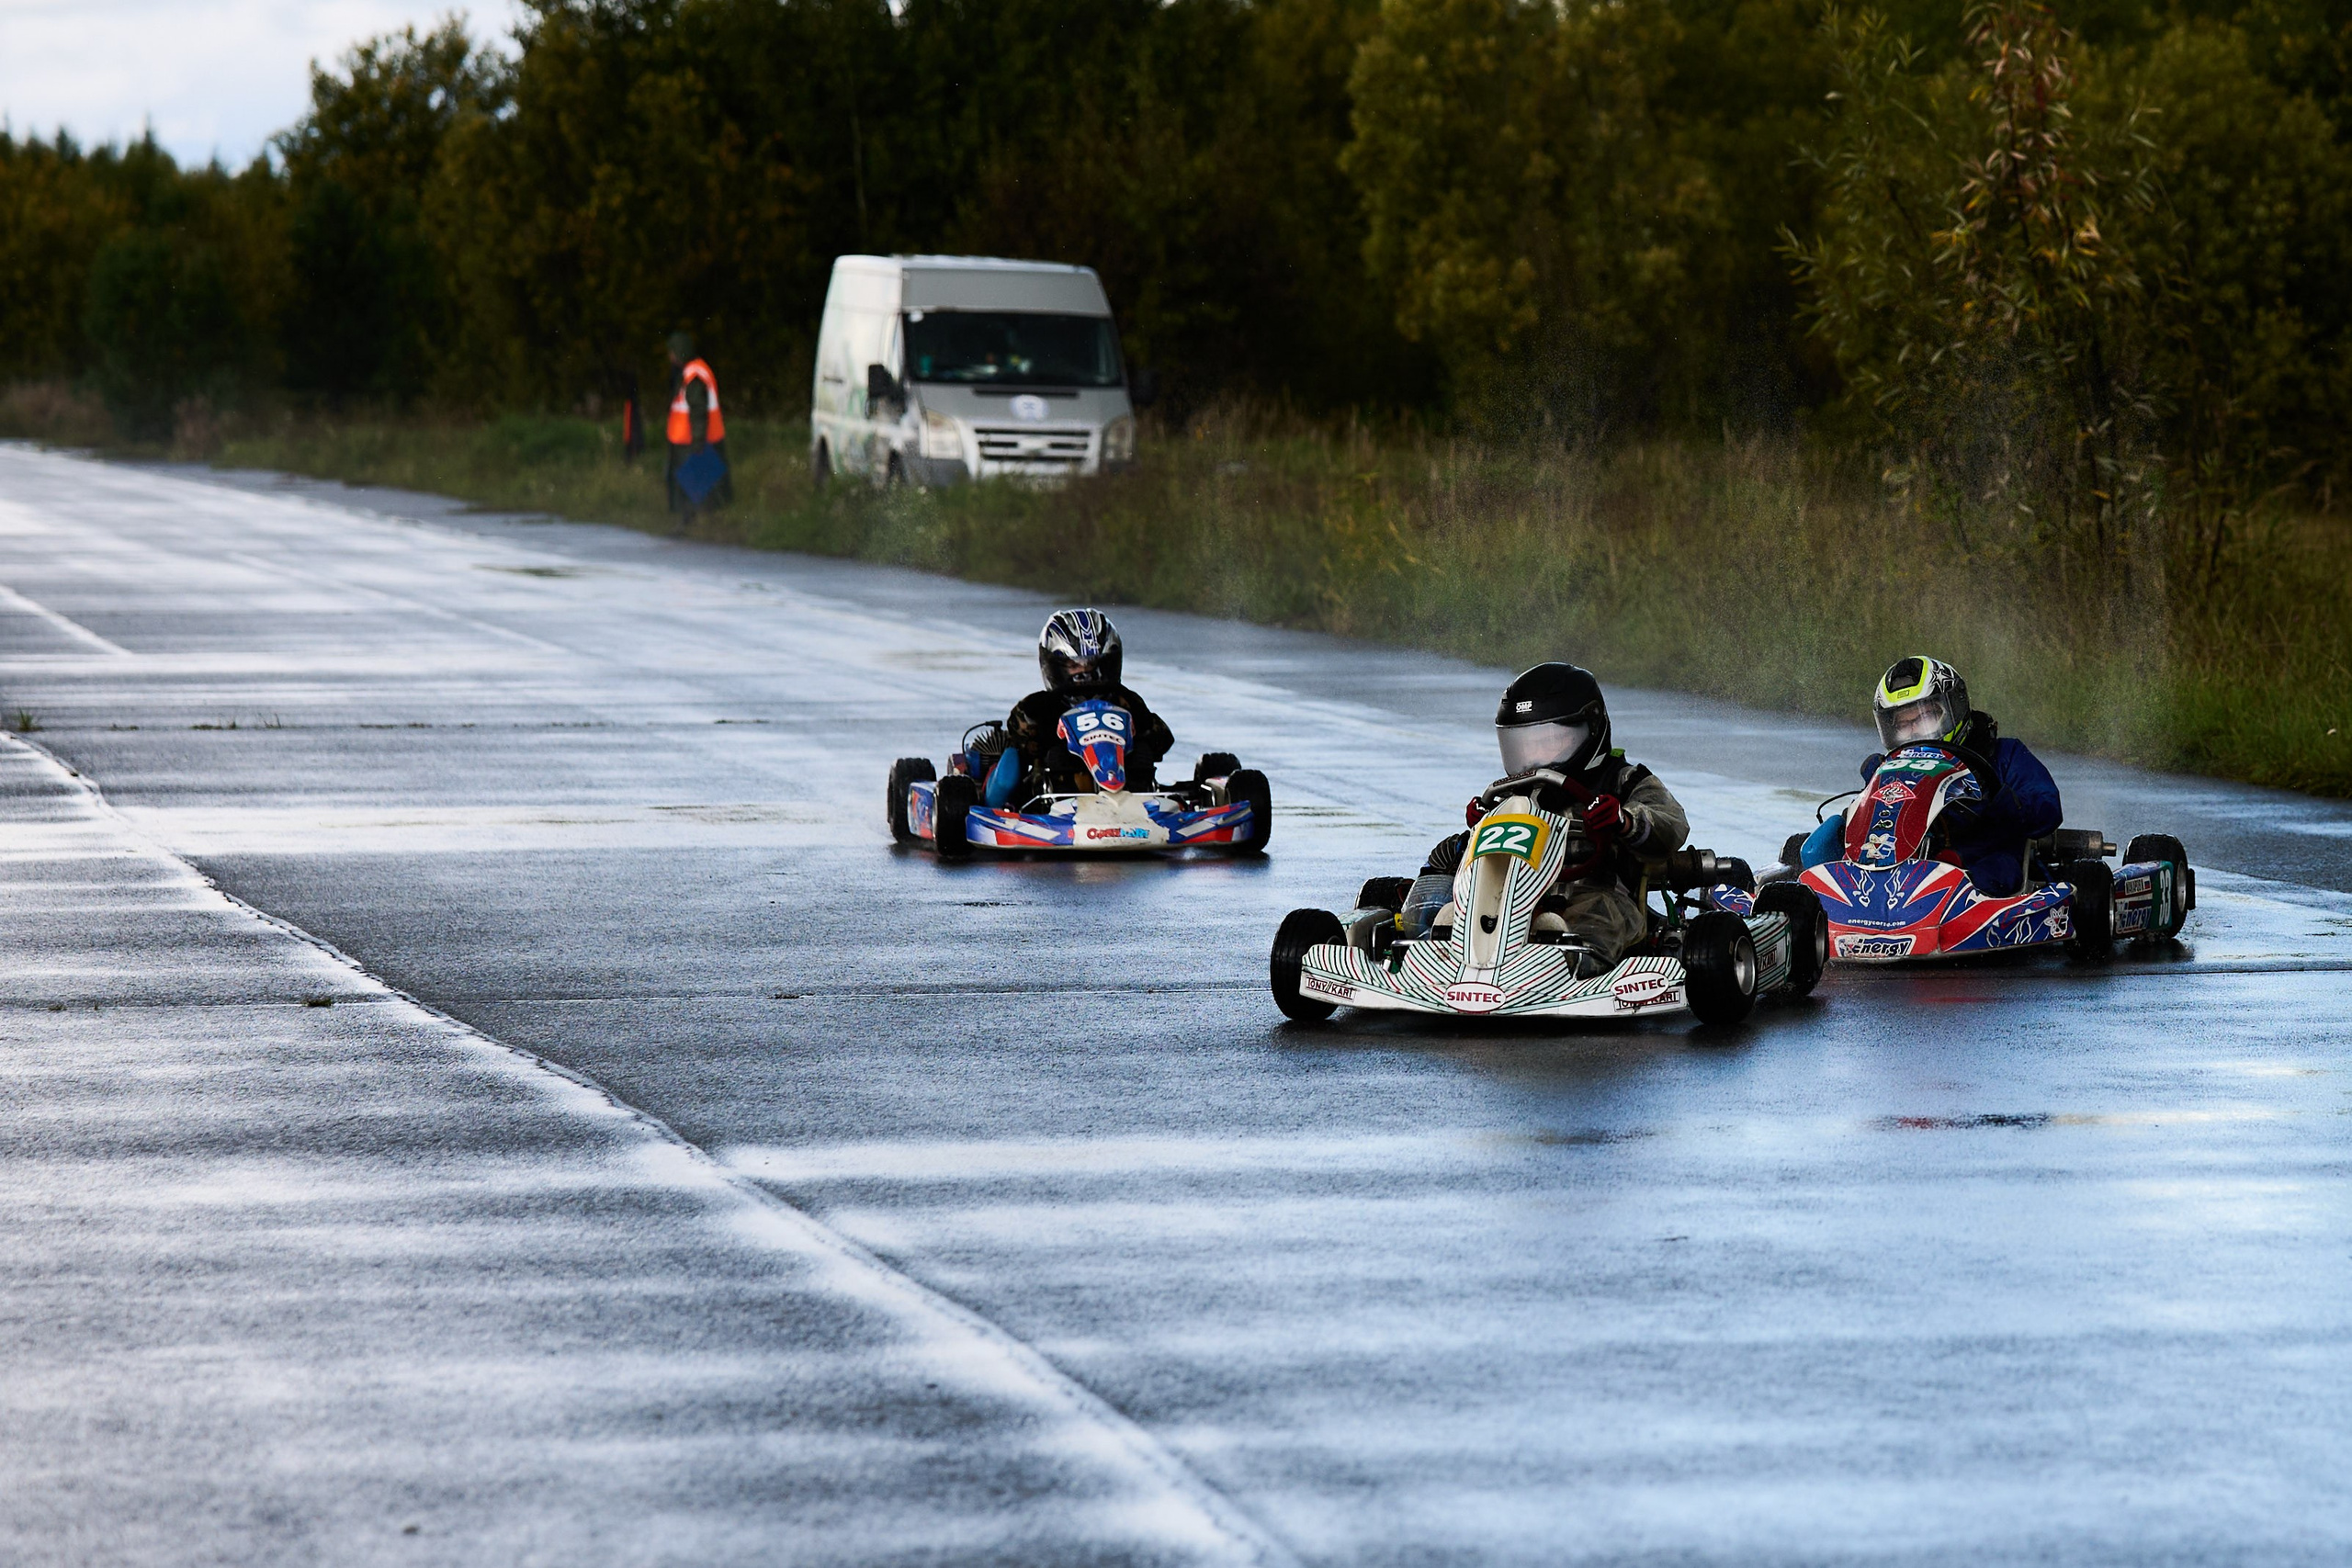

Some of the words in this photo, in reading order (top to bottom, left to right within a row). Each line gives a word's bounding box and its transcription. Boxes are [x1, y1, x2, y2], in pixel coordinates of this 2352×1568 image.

[1077, 712, 1125, 732] 56
[1083, 734, 1122, 743] SINTEC
[1882, 759, 1940, 771] 33
[1476, 826, 1532, 853] 22
[2158, 869, 2172, 927] 33
[1614, 978, 1666, 996] SINTEC
[1447, 991, 1501, 1003] SINTEC
